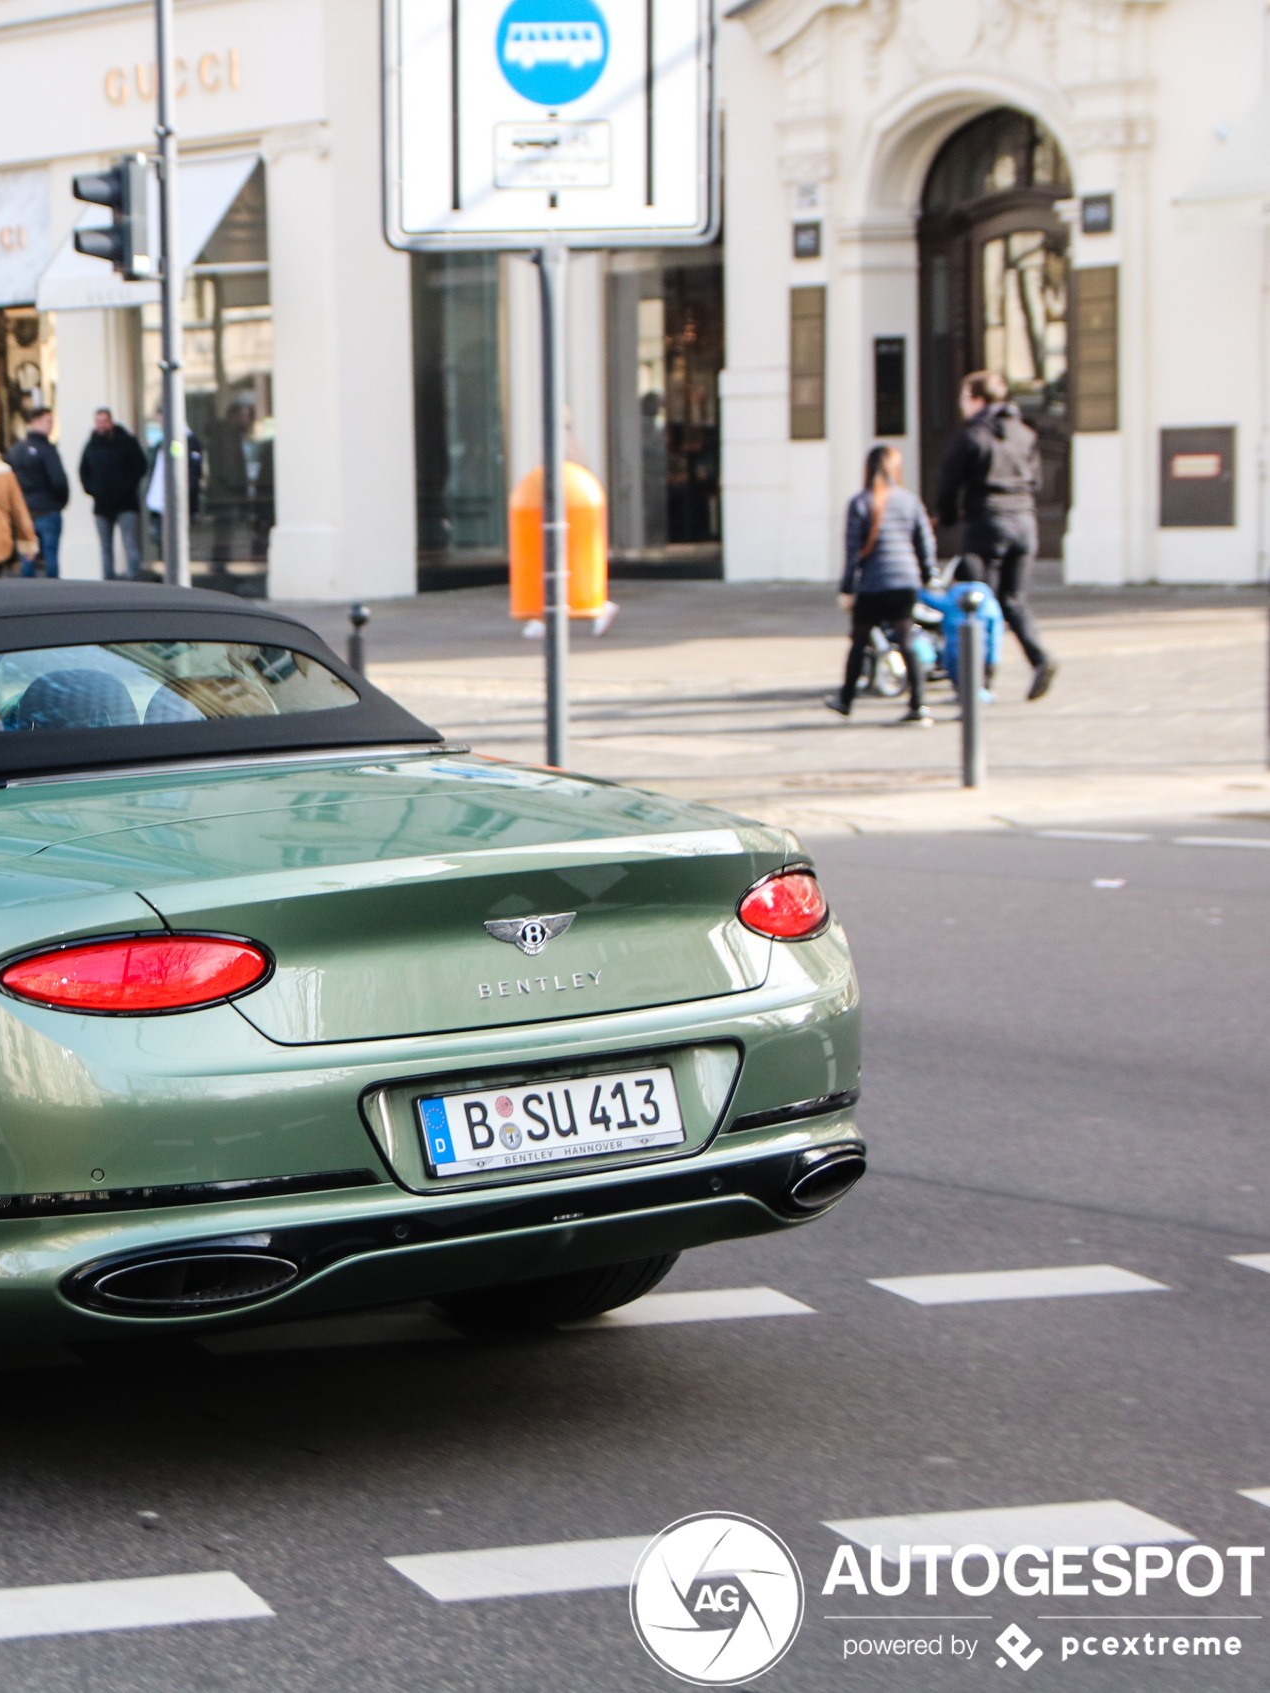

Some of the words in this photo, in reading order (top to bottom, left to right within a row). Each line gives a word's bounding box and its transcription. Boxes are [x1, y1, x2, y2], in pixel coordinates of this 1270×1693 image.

[104, 47, 240, 107] GUCCI
[478, 969, 602, 999] BENTLEY
[463, 1101, 495, 1150] B
[522, 1088, 578, 1141] SU
[589, 1078, 661, 1132] 413
[434, 1138, 447, 1153] D
[504, 1150, 553, 1165] BENTLEY
[564, 1141, 623, 1156] HANNOVER
